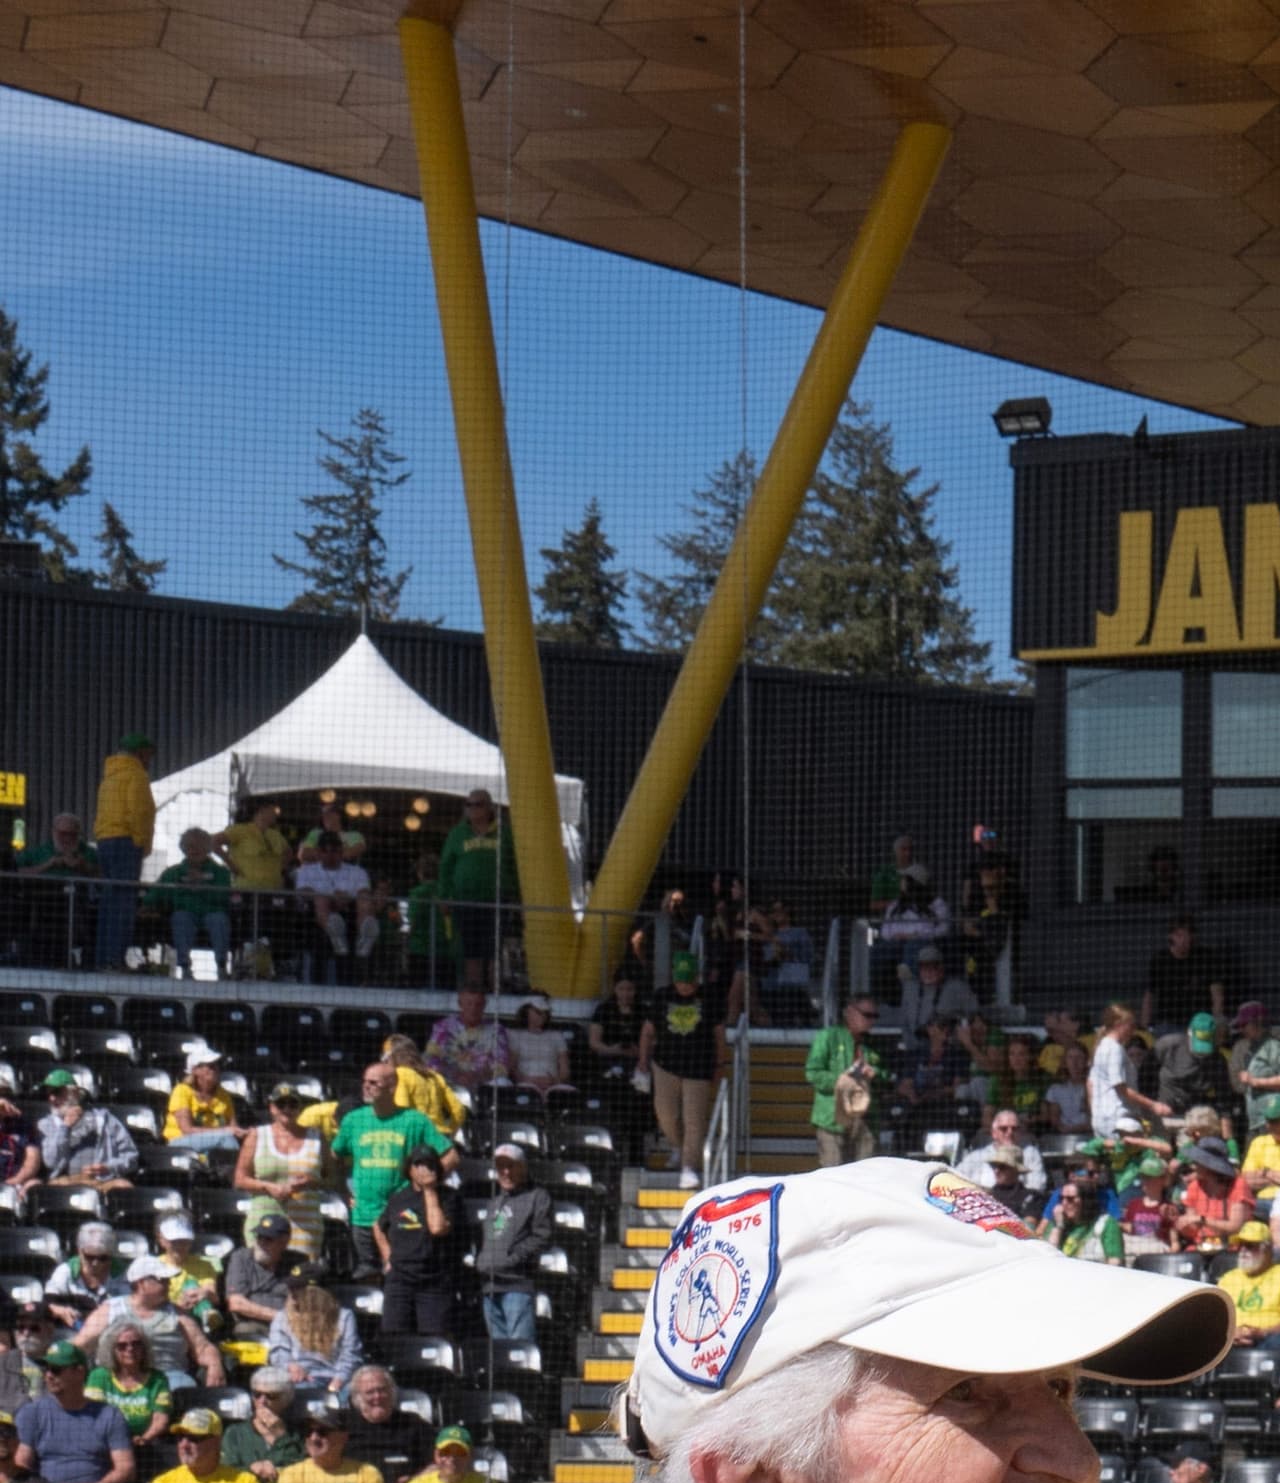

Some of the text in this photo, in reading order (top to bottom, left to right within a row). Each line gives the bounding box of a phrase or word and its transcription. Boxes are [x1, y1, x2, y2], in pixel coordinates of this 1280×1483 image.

[728, 1213, 762, 1234] 1976
[714, 1239, 745, 1269] WORLD
[732, 1269, 751, 1318] SERIES
